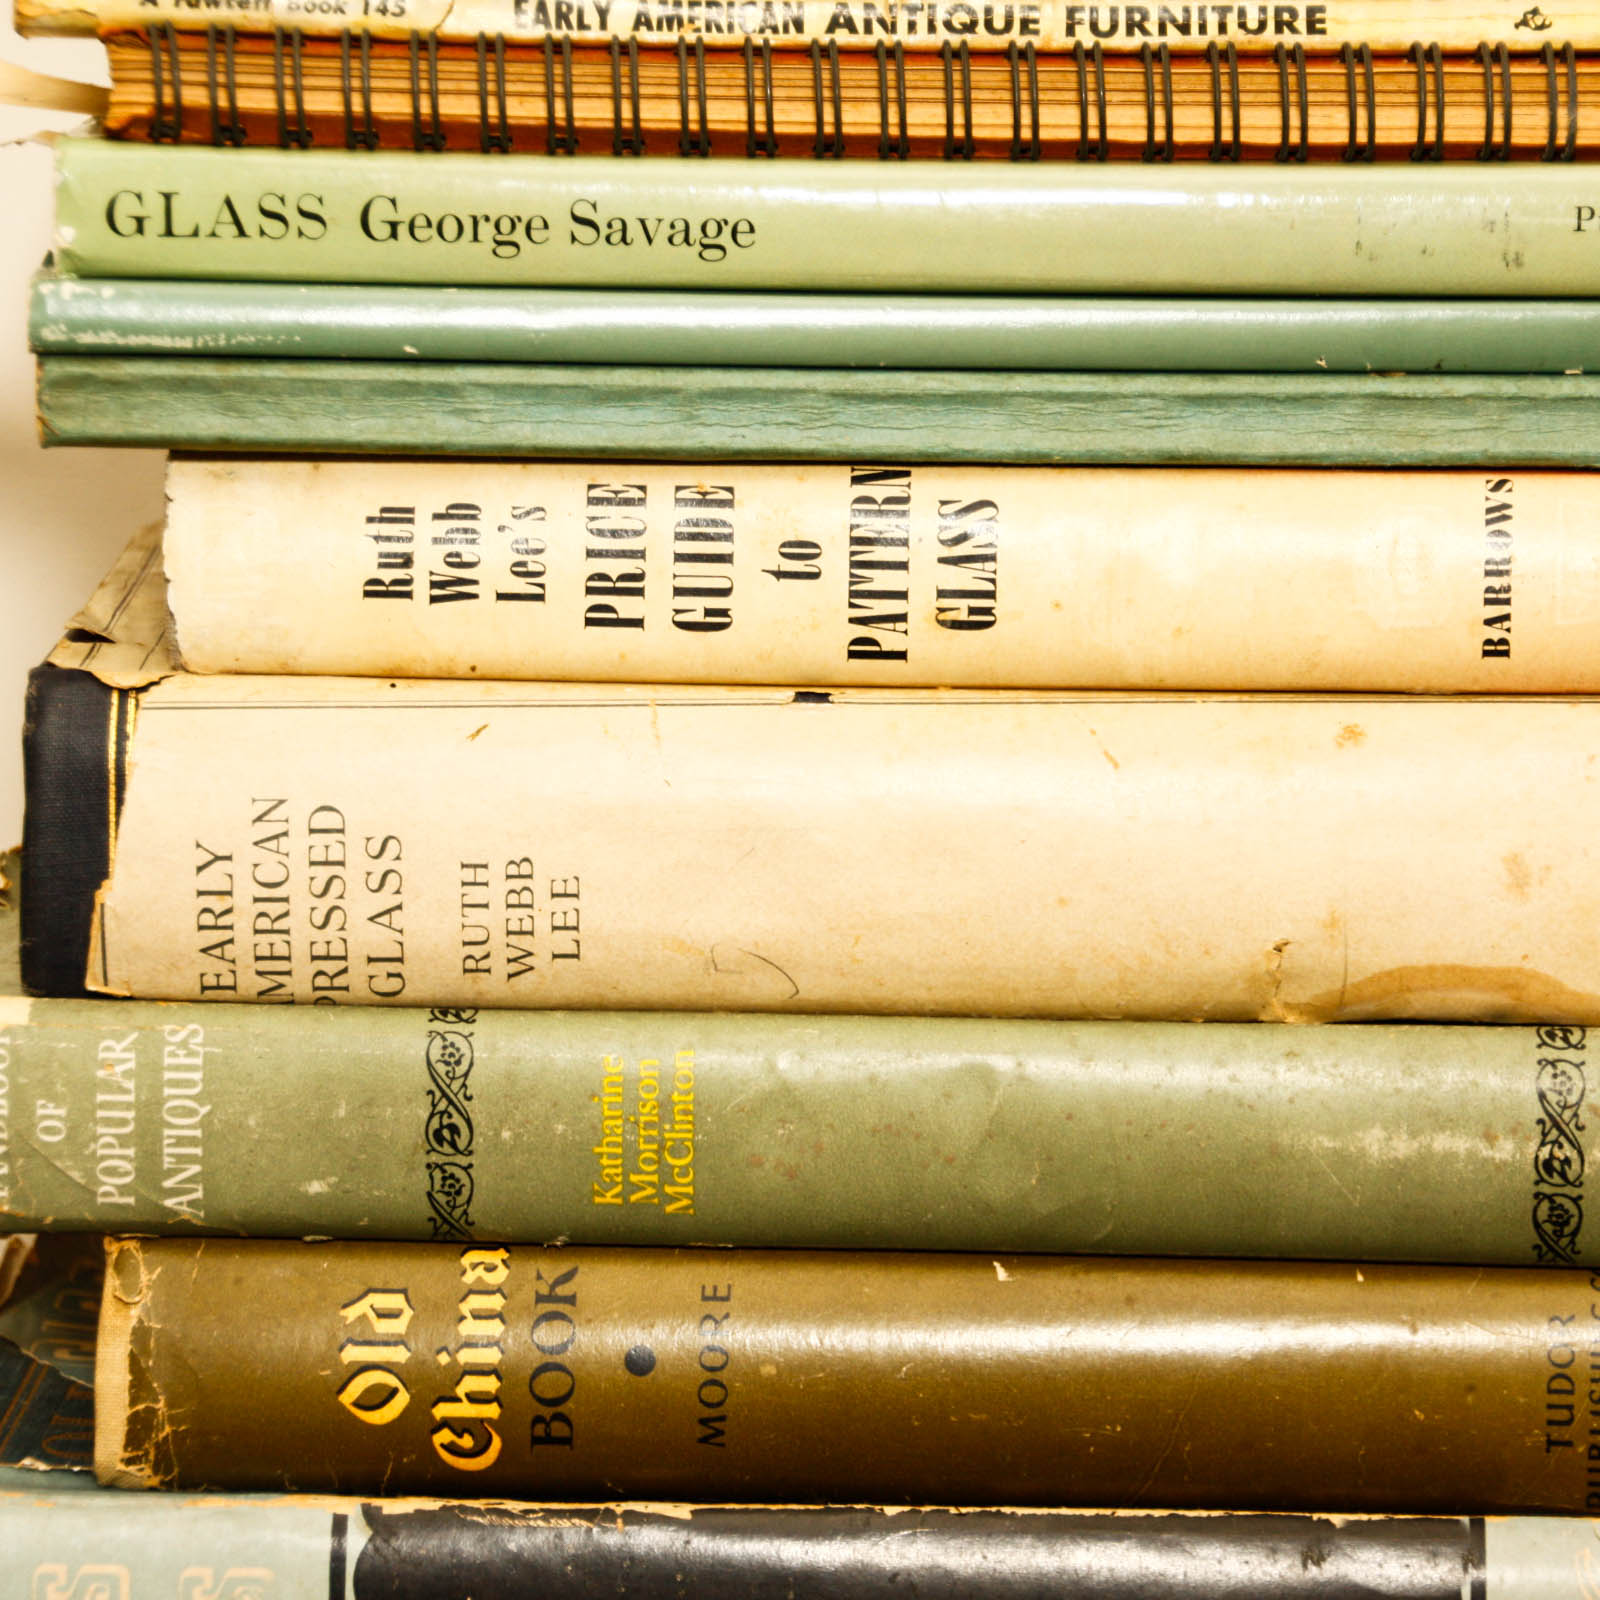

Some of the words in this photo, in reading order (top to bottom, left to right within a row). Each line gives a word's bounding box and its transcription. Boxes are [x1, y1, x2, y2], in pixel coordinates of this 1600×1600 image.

[361, 0, 407, 17] 145
[513, 0, 609, 32] EARLY
[634, 0, 804, 35] AMERICAN
[825, 2, 1041, 36] ANTIQUE
[1065, 4, 1327, 39] FURNITURE
[105, 190, 328, 240] GLASS
[359, 194, 550, 259] George
[569, 199, 757, 262] Savage
[1573, 205, 1600, 233] P
[363, 506, 416, 600] Ruth
[429, 502, 481, 605] Webb
[496, 505, 547, 603] Lee's
[584, 483, 647, 631] PRICE
[671, 485, 735, 632] GUIDE
[762, 538, 823, 582] to
[847, 466, 911, 663] PATTERN
[935, 498, 999, 631] GLASS
[1482, 478, 1514, 659] BARROWS
[195, 839, 238, 996] EARLY
[251, 797, 295, 1004] MERICAN
[365, 834, 406, 998] GLASS
[460, 860, 491, 976] RUTH
[505, 856, 535, 982] WEBB
[551, 874, 581, 962] LEE
[36, 1099, 68, 1142] OF
[96, 1031, 139, 1206] POPULAR
[161, 1023, 212, 1219] ANTIQUES
[592, 1054, 624, 1206] Katharine
[629, 1058, 659, 1205] Morrison
[664, 1049, 695, 1216] McClinton
[337, 1287, 414, 1425] Old
[431, 1246, 511, 1471] China
[528, 1264, 579, 1454] BOOK
[697, 1283, 732, 1448] MOORE
[1545, 1313, 1576, 1453] TUDOR
